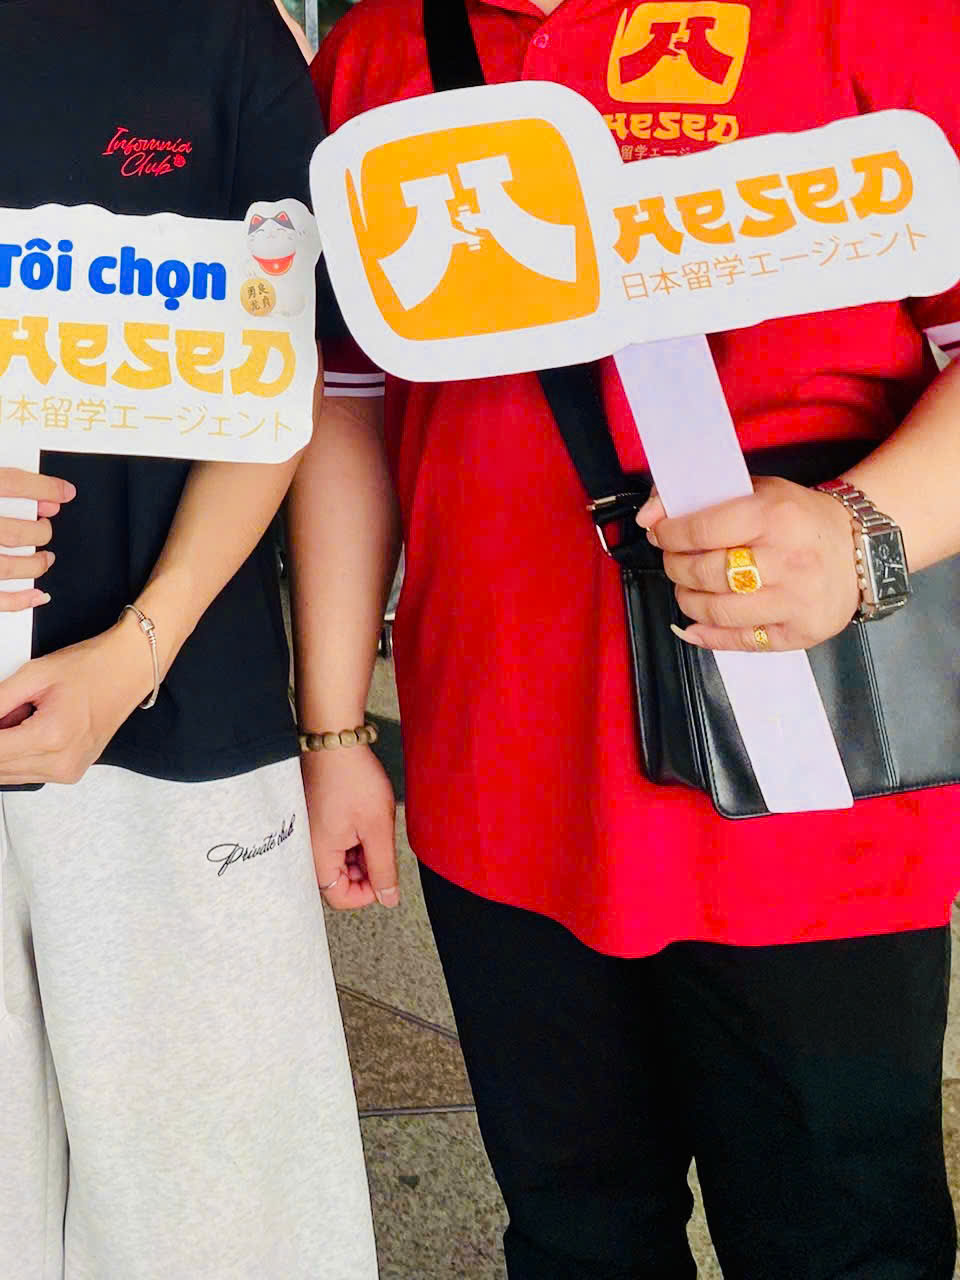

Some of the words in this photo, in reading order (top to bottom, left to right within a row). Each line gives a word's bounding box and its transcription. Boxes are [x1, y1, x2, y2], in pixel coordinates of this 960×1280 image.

[120, 152, 175, 177] Club
[88, 246, 227, 310] chọn
[622, 223, 927, 301] 日本留学エージェント
[206, 832, 278, 876] Private
